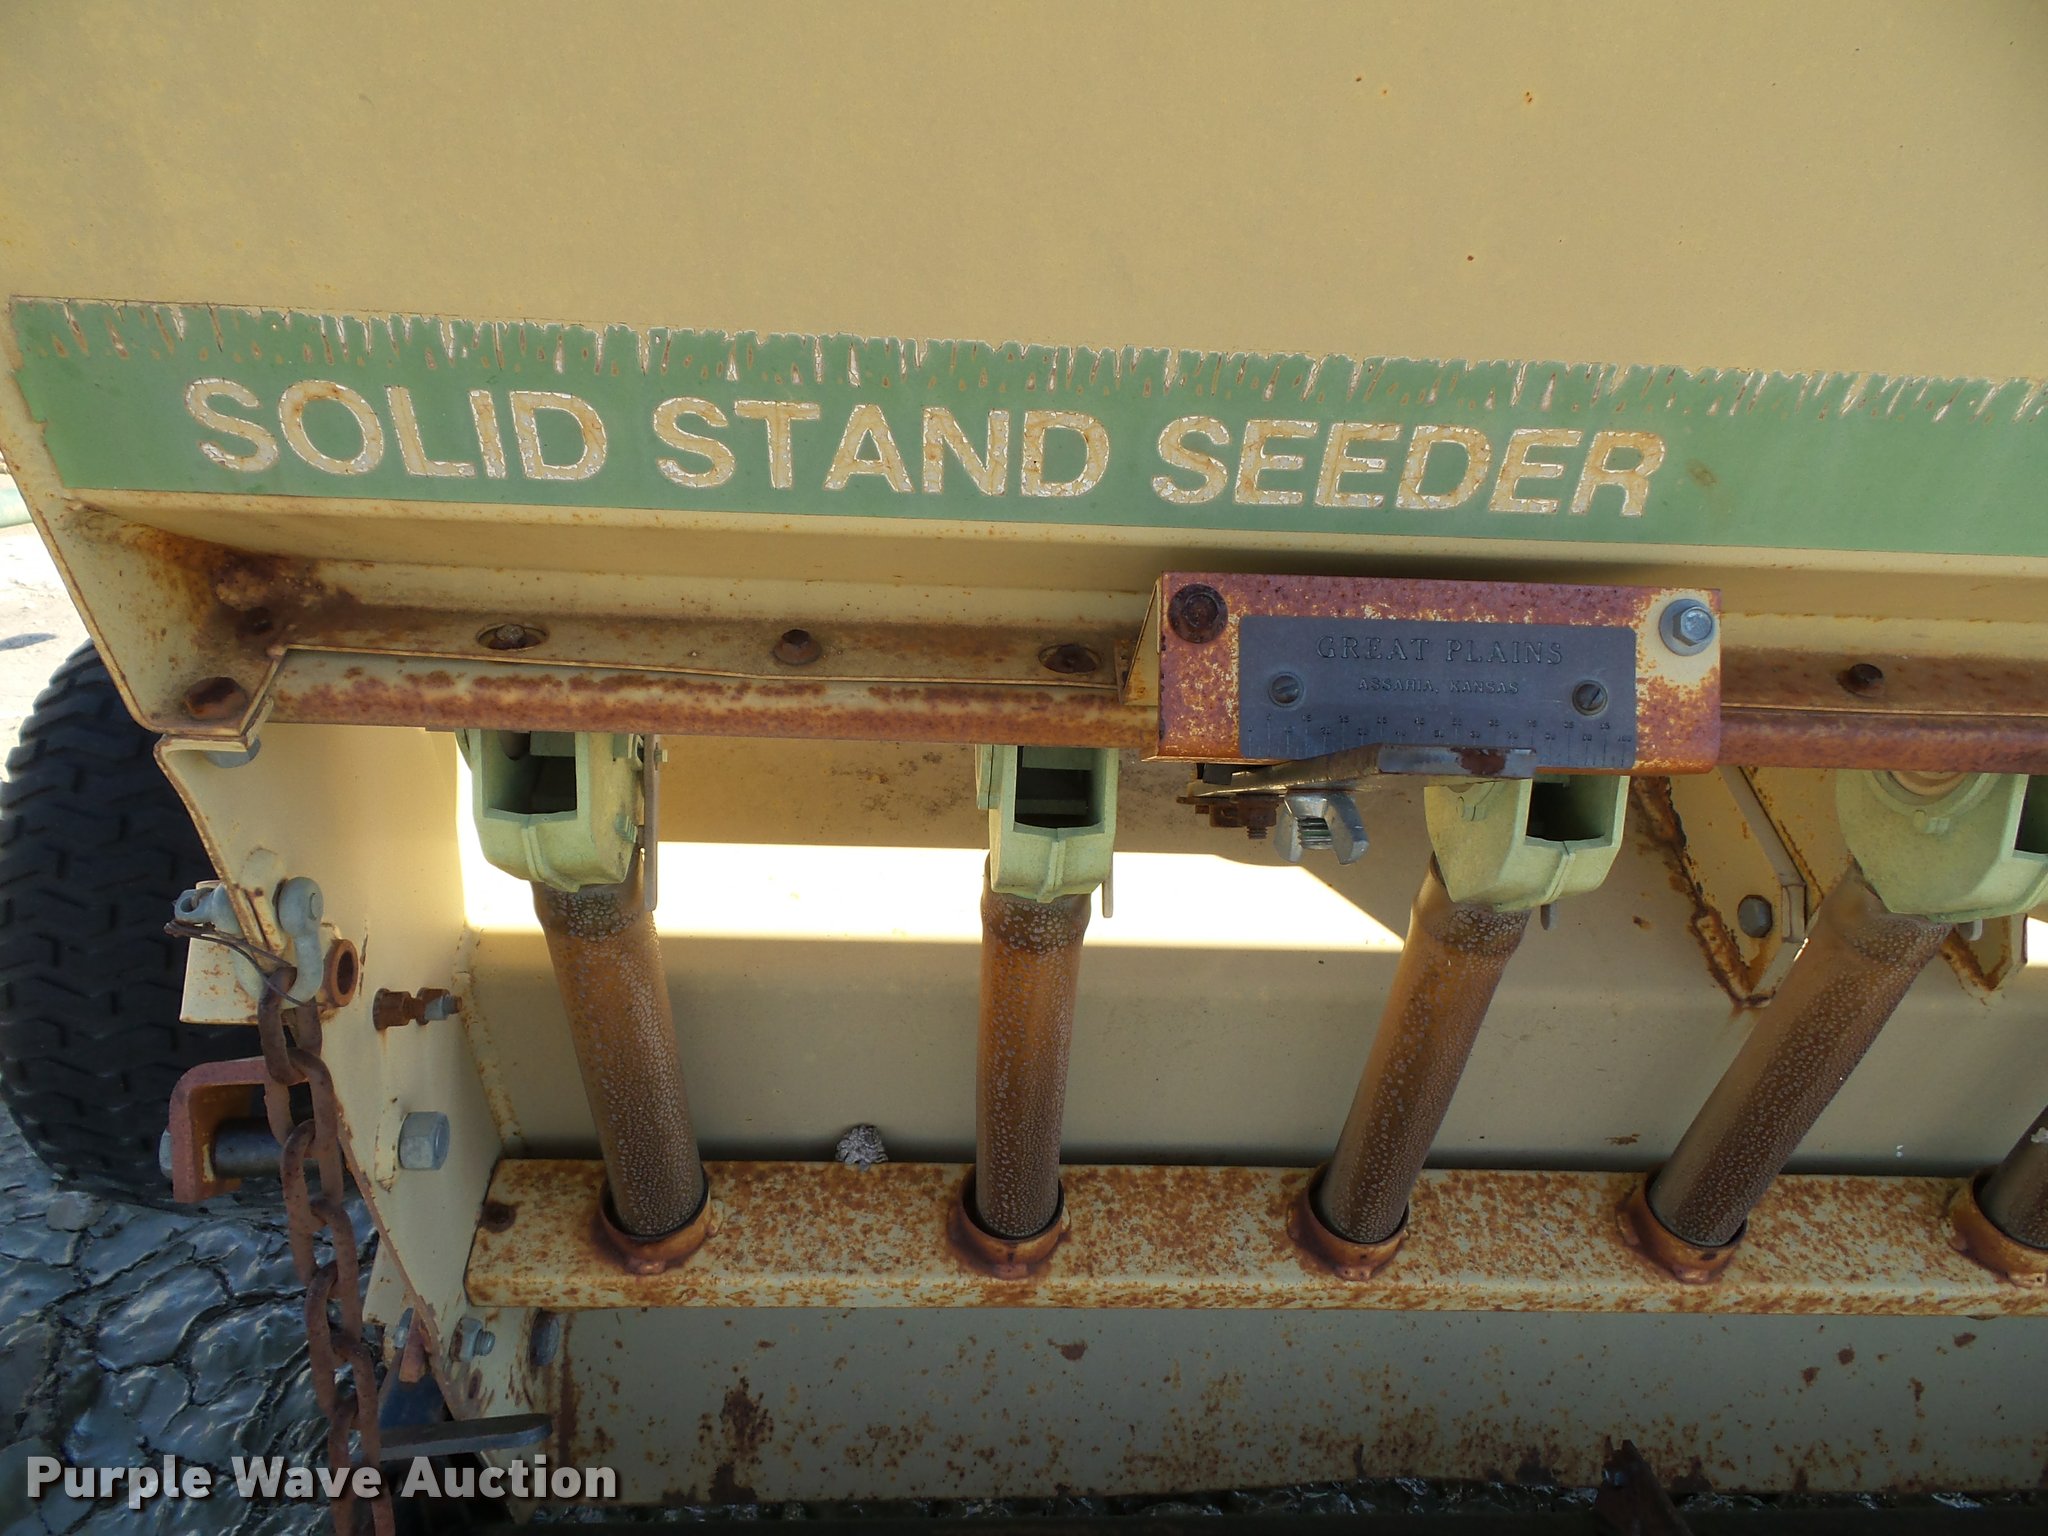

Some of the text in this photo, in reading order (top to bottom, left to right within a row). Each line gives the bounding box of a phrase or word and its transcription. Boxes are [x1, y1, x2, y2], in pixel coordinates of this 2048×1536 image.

[184, 377, 1666, 517] SOLID STAND SEEDER
[1316, 635, 1564, 665] GREAT PLAINS
[1357, 677, 1520, 695] ASSARIA, KANSAS
